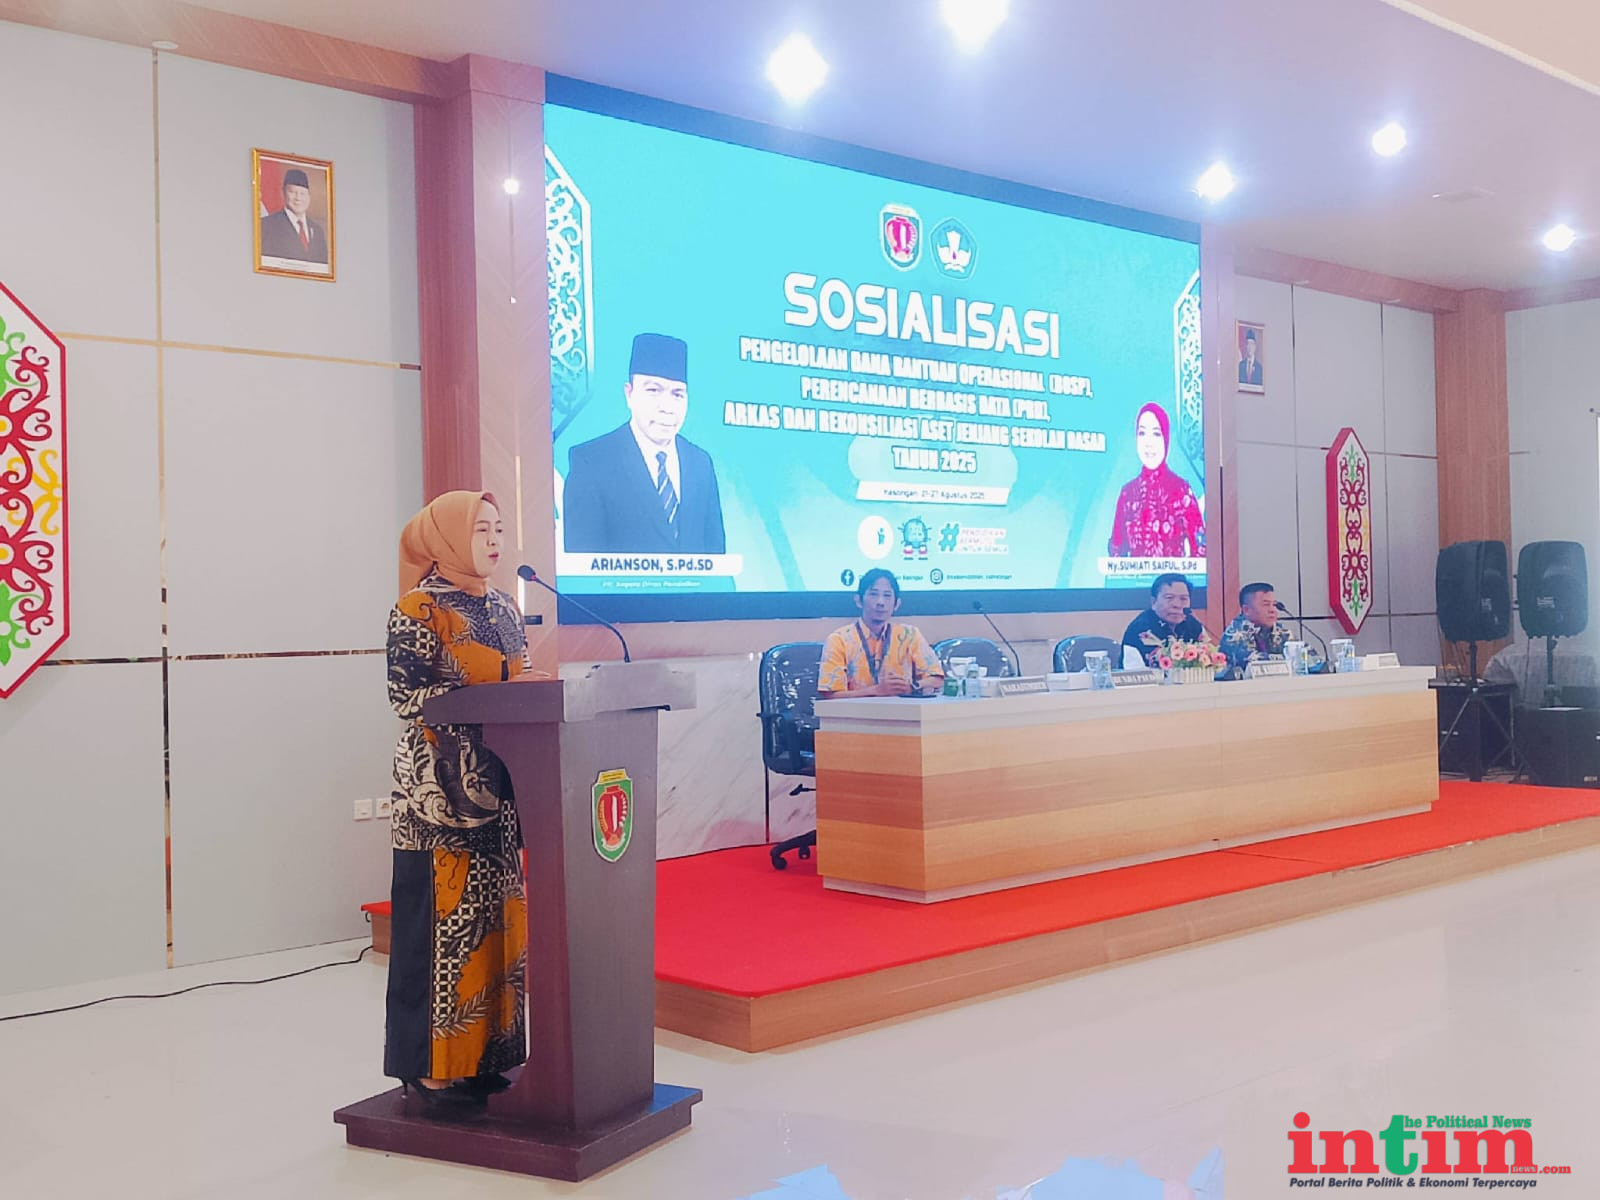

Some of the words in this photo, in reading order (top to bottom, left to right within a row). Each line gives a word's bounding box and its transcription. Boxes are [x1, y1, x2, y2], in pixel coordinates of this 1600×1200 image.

[784, 272, 1060, 359] SOSIALISASI
[739, 336, 849, 372] PENGELOLAAN
[851, 350, 892, 377] DANA
[892, 355, 957, 383] BANTUAN
[959, 363, 1046, 392] OPERASIONAL
[801, 375, 907, 409] PERENCANAAN
[908, 388, 976, 415] BERBASIS
[978, 395, 1011, 417] DATA
[723, 402, 781, 429] ARKAS
[782, 405, 816, 431] DAN
[818, 408, 919, 439] REKONSILIASI
[920, 417, 954, 442] ASET
[955, 421, 1010, 447] JENJANG
[1011, 426, 1066, 449] SEKOLAH
[1067, 430, 1106, 452] DASAR
[891, 445, 939, 471] TAHUN
[941, 449, 977, 473] 2025
[591, 557, 664, 573] ARIANSON,
[666, 557, 713, 571] S.Pd.SD
